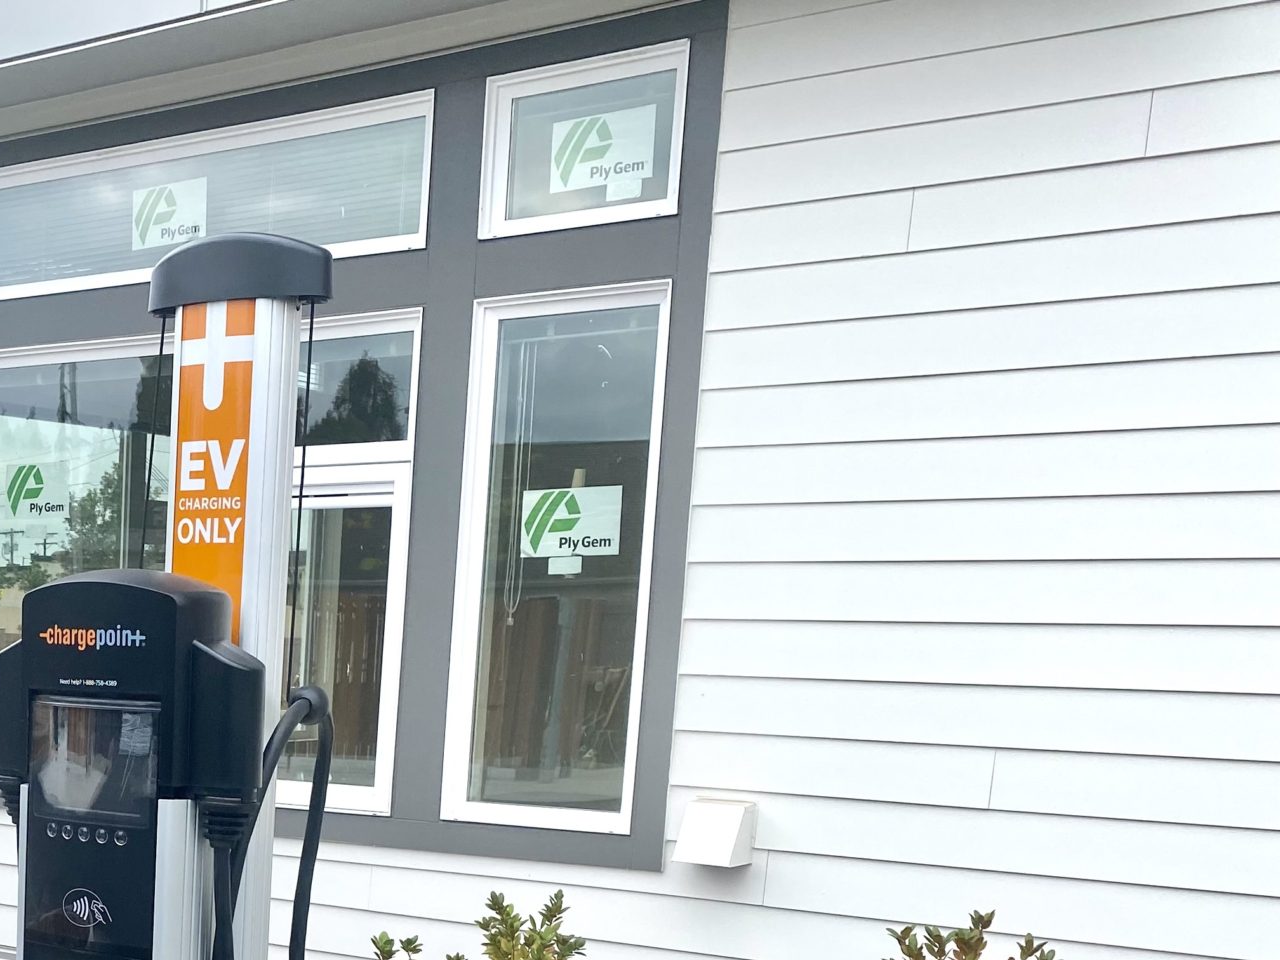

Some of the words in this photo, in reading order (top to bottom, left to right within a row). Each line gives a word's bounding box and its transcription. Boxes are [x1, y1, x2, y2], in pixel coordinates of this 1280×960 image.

[589, 165, 611, 181] Ply
[613, 160, 645, 175] Gem
[160, 227, 176, 240] Ply
[177, 224, 200, 236] Gem
[179, 438, 246, 491] EV
[29, 502, 44, 515] Ply
[44, 502, 64, 513] Gem
[178, 496, 241, 511] CHARGING
[176, 516, 243, 544] ONLY
[558, 537, 580, 552] Ply
[581, 535, 611, 548] Gem
